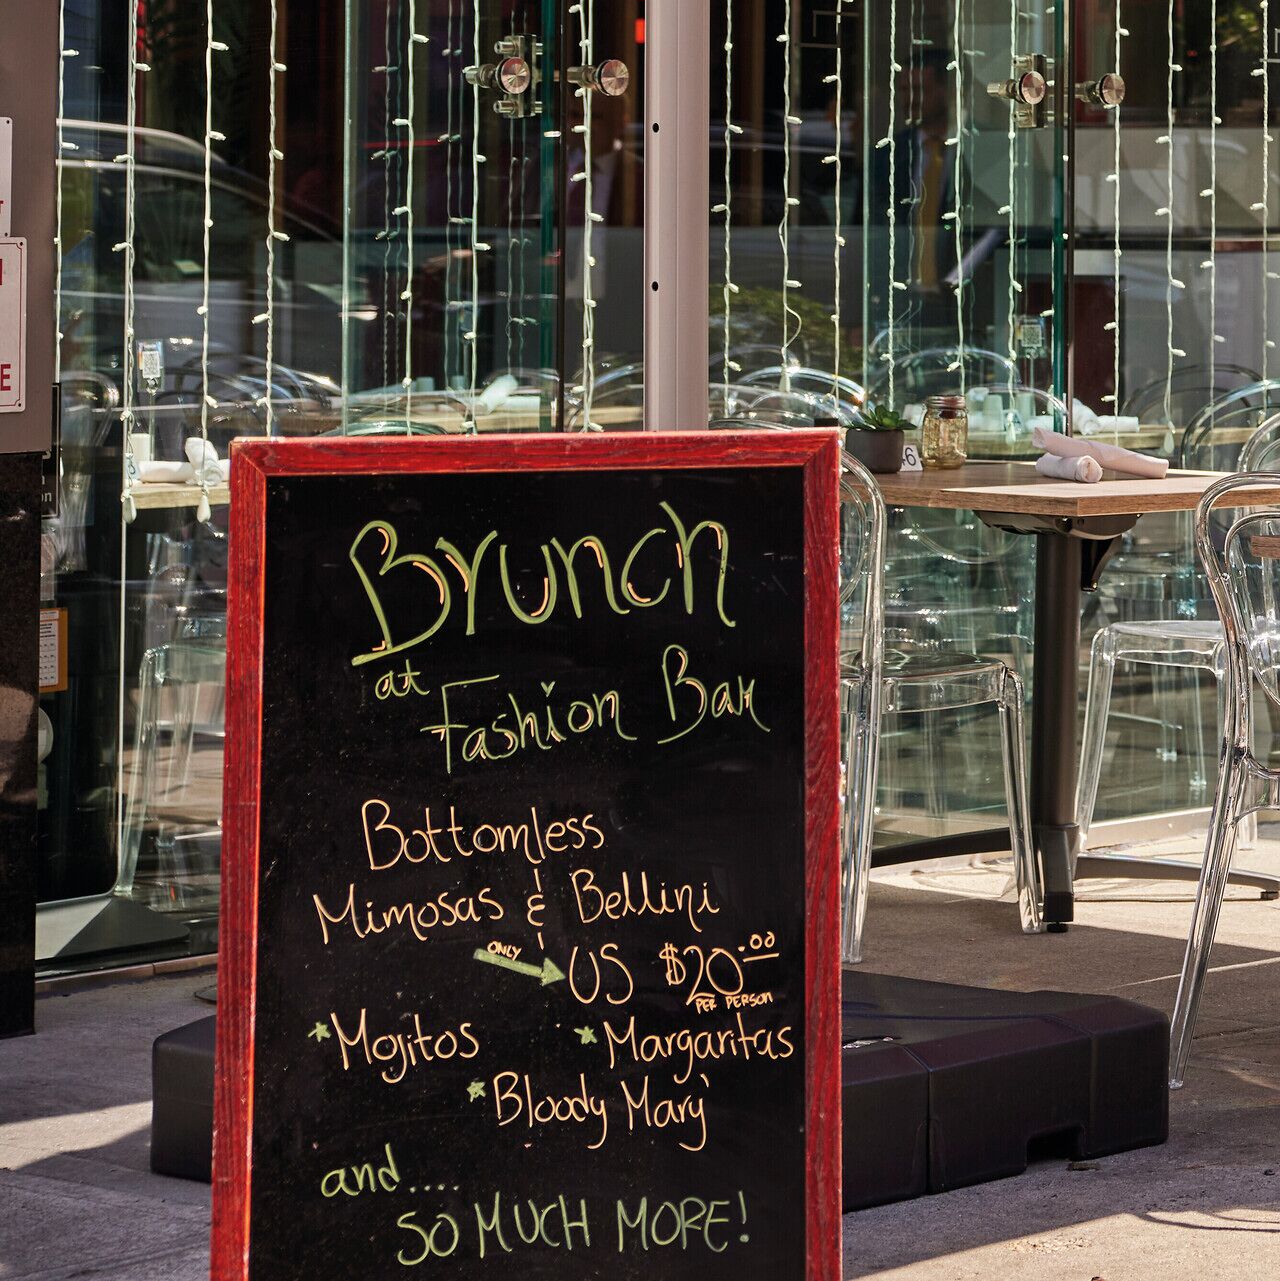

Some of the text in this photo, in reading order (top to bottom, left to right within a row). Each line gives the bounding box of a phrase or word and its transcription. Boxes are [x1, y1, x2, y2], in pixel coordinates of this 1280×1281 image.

[349, 500, 737, 667] Brunch
[374, 659, 430, 700] at
[419, 643, 772, 774] Fashion Bar
[360, 799, 605, 871] Bottomless
[312, 883, 504, 945] Mimosas
[570, 868, 720, 933] Bellini
[486, 941, 523, 961] ONLY
[569, 942, 634, 1005] US
[695, 991, 774, 1014] PER PERSON
[330, 1007, 480, 1084] Mojitos
[603, 1012, 795, 1084] Margaritas
[492, 1071, 607, 1150] Bloody
[396, 1190, 751, 1266] SO MUCH MORE!
